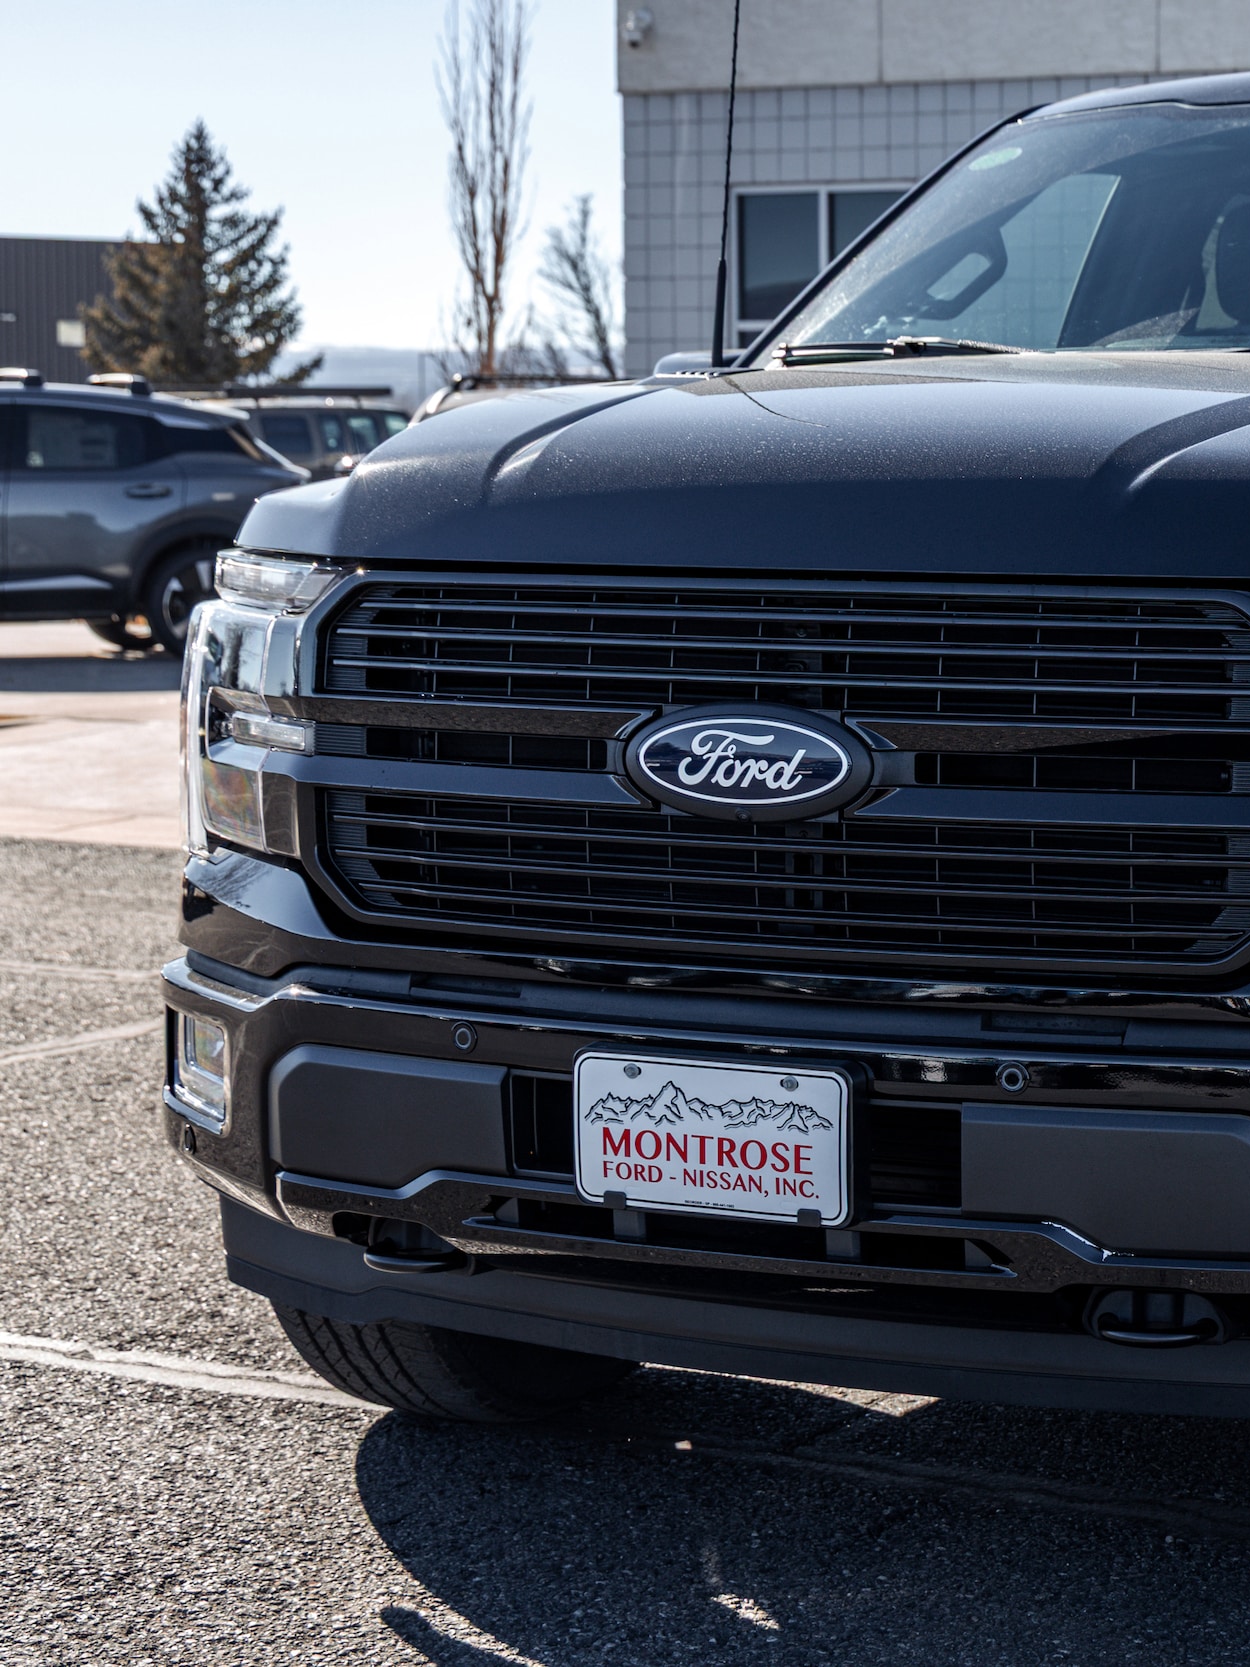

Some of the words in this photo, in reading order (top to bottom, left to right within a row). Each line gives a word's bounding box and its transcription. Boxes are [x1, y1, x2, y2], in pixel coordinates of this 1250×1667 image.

[678, 729, 807, 790] Ford
[602, 1126, 814, 1176] MONTROSE
[602, 1160, 664, 1184] FORD
[683, 1168, 769, 1198] NISSAN,
[775, 1177, 820, 1200] INC.
